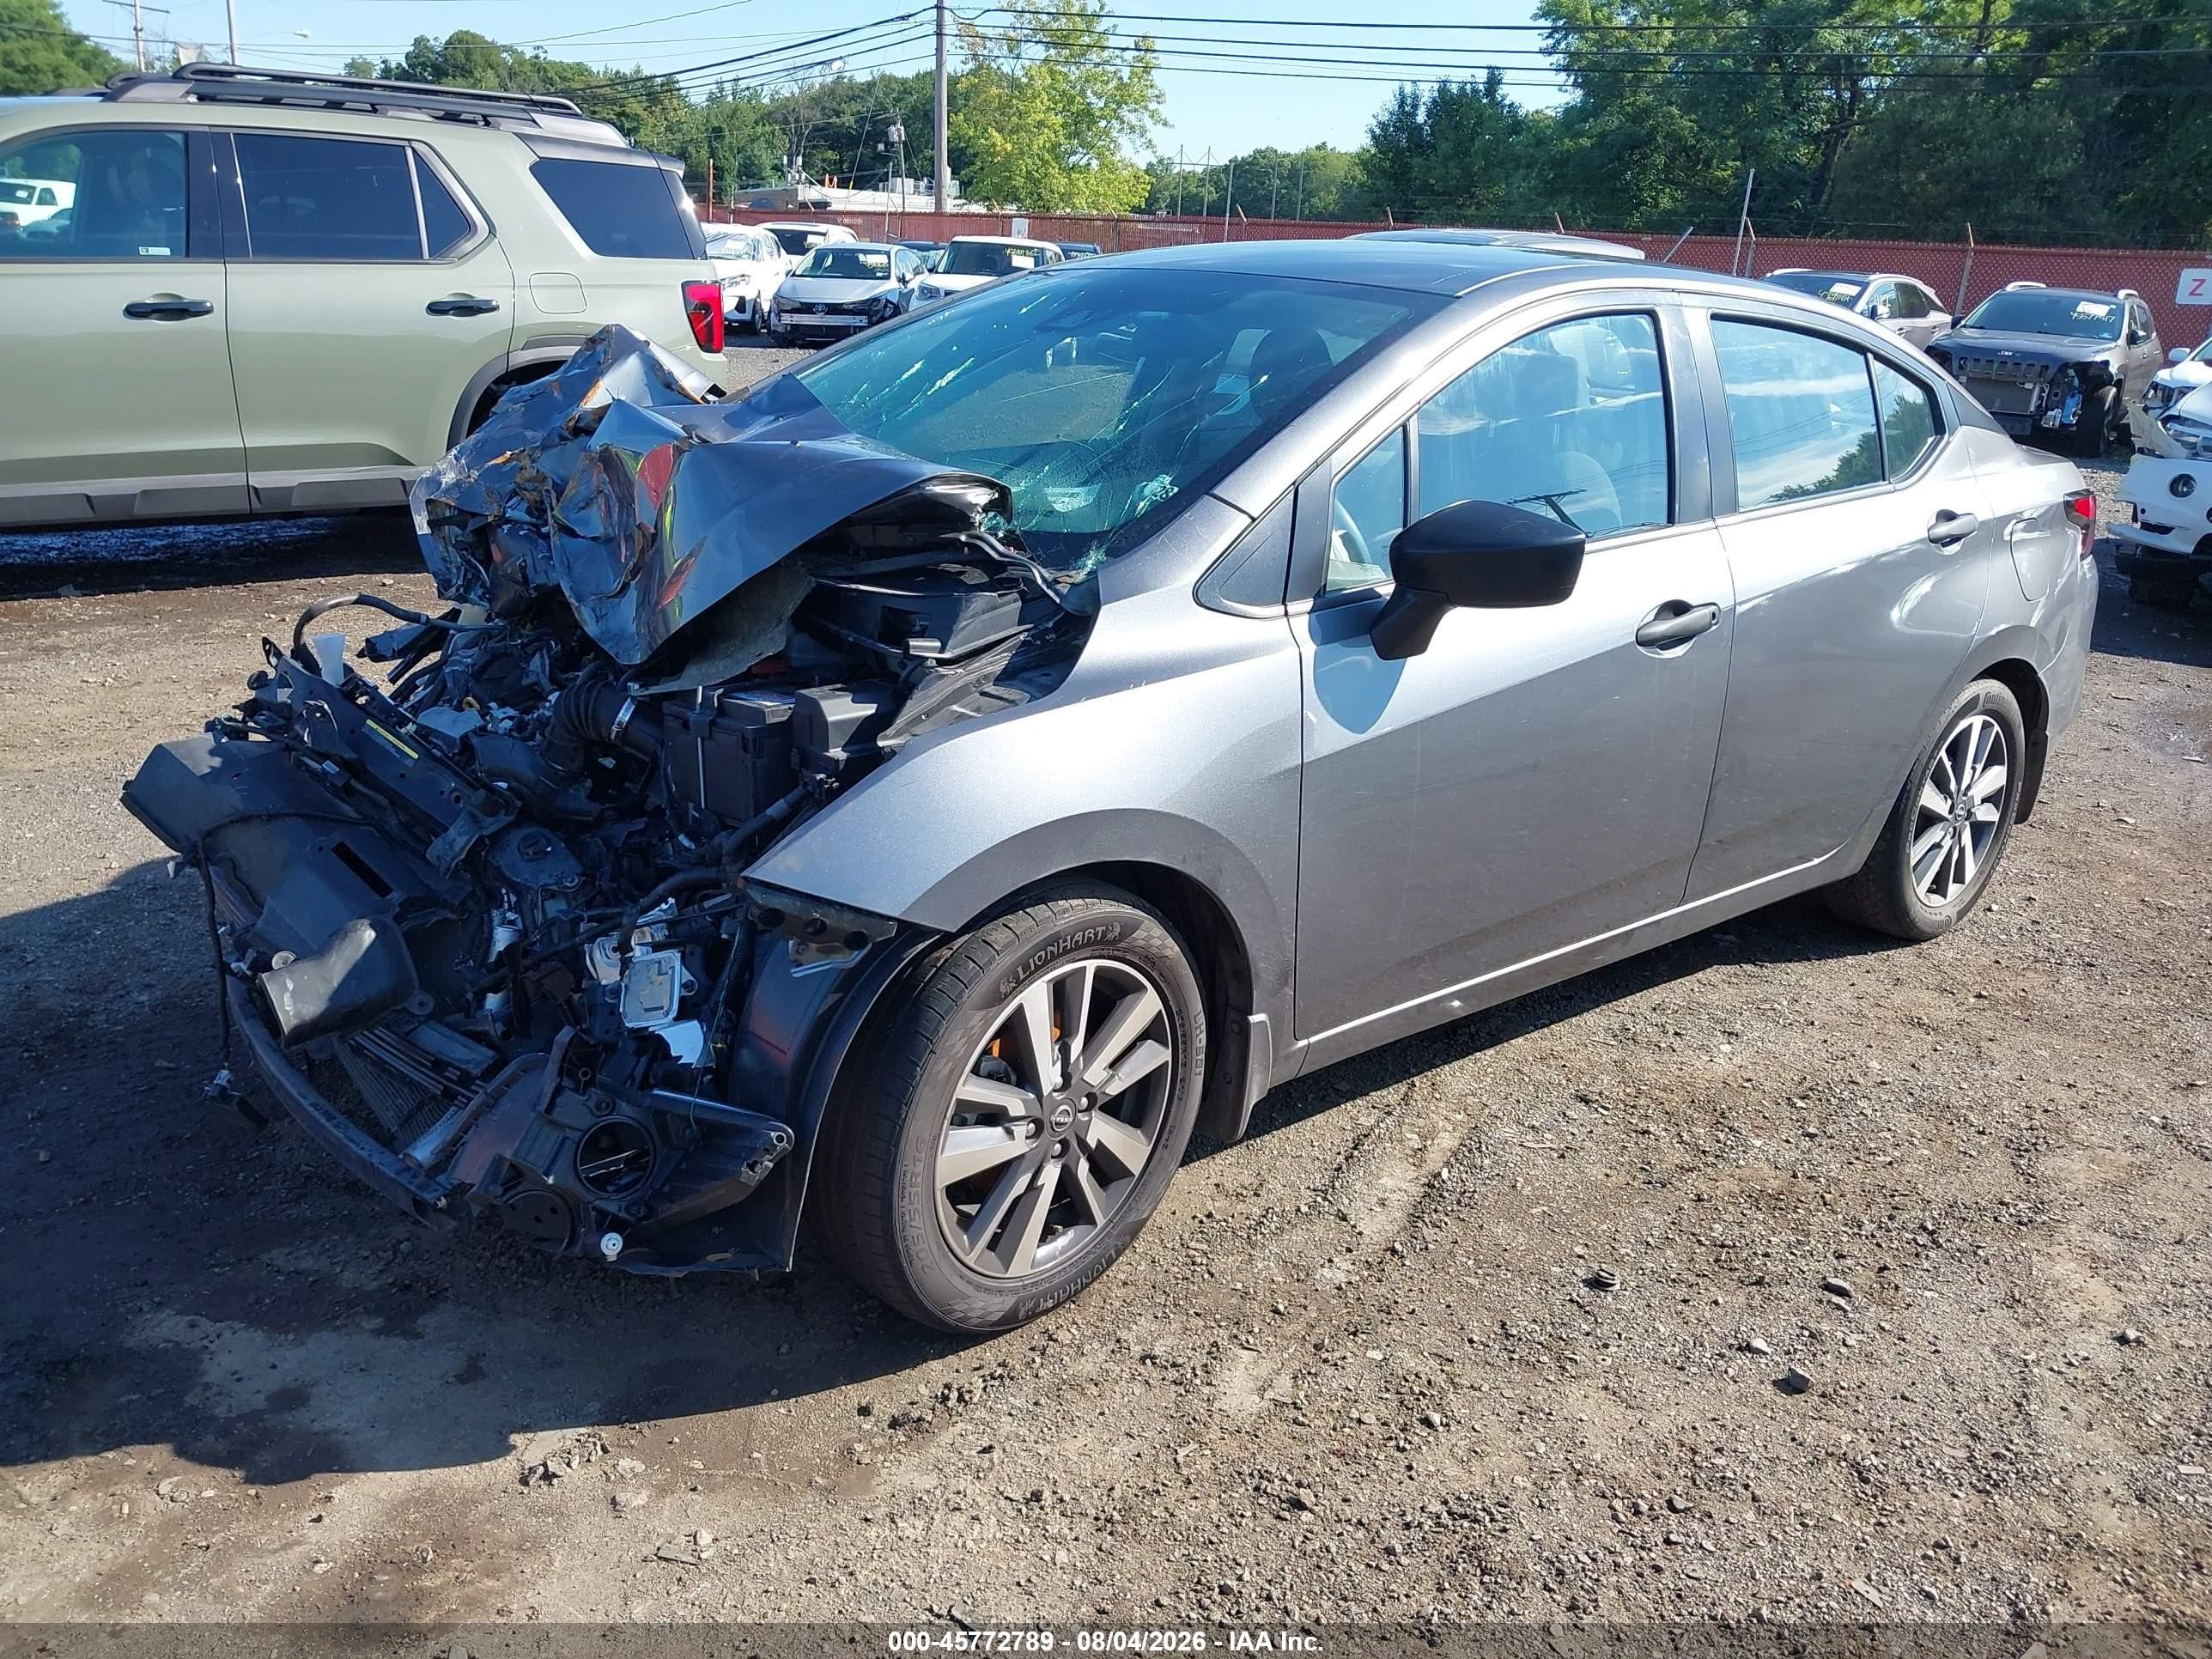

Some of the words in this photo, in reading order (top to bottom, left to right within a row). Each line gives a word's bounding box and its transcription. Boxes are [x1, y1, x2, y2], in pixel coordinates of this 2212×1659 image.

[2188, 278, 2206, 296] Z
[1016, 926, 1106, 981] LIONHART
[908, 1135, 935, 1276] 205/55R16
[1036, 1248, 1117, 1314] LIONHART
